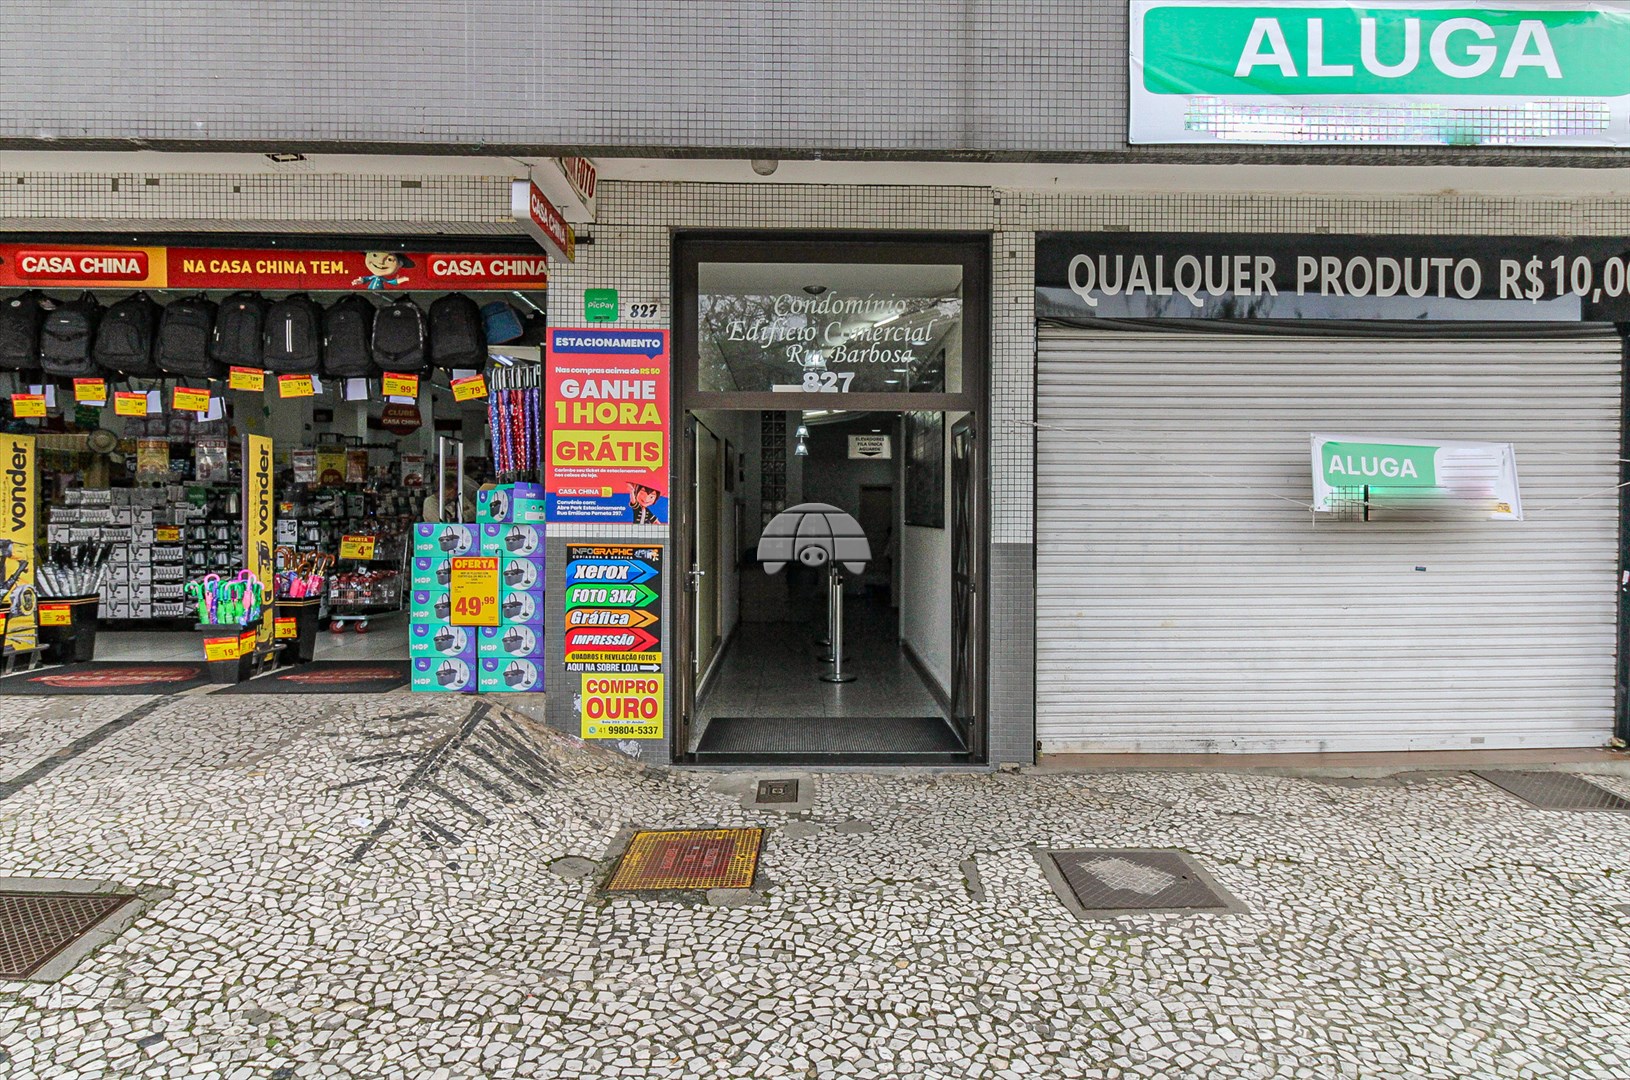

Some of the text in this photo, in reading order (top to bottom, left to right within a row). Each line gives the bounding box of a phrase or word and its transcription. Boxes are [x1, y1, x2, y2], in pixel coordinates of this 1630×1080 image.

[1234, 17, 1562, 79] ALUGA
[531, 194, 549, 227] CASA
[22, 256, 141, 274] CASA CHINA
[183, 259, 349, 275] NA CASA CHINA TEM.
[433, 260, 548, 276] CASA CHINA
[1067, 253, 1630, 308] QUALQUER PRODUTO R$10,0
[588, 301, 614, 310] PicPay
[630, 304, 658, 318] 827
[774, 291, 906, 316] Condomínio
[824, 319, 938, 343] Comercial
[556, 337, 661, 348] ESTACIONAMENTO
[831, 342, 913, 363] Barbosa
[571, 367, 604, 376] compras
[560, 378, 656, 400] GANHE
[802, 371, 856, 393] 827
[388, 409, 415, 417] CLUBE
[555, 401, 662, 424] 1 HORA
[556, 434, 660, 462] GRÁTIS
[1328, 454, 1418, 479] ALUGA
[573, 547, 633, 556] INFOGRAPHIC
[454, 559, 495, 569] OFERTA
[574, 565, 630, 579] xerox
[572, 588, 637, 603] FOTO 3X4
[570, 610, 630, 625] Gráfica
[571, 634, 635, 646] IMPRESSÃO
[604, 652, 637, 661] REVELAÇÃO
[567, 663, 584, 671] AQUI
[597, 664, 620, 672] SOBRE
[622, 664, 639, 672] LOJA
[586, 679, 659, 694] COMPRO
[586, 697, 658, 719] OURO
[609, 725, 658, 734] 99804-5337
